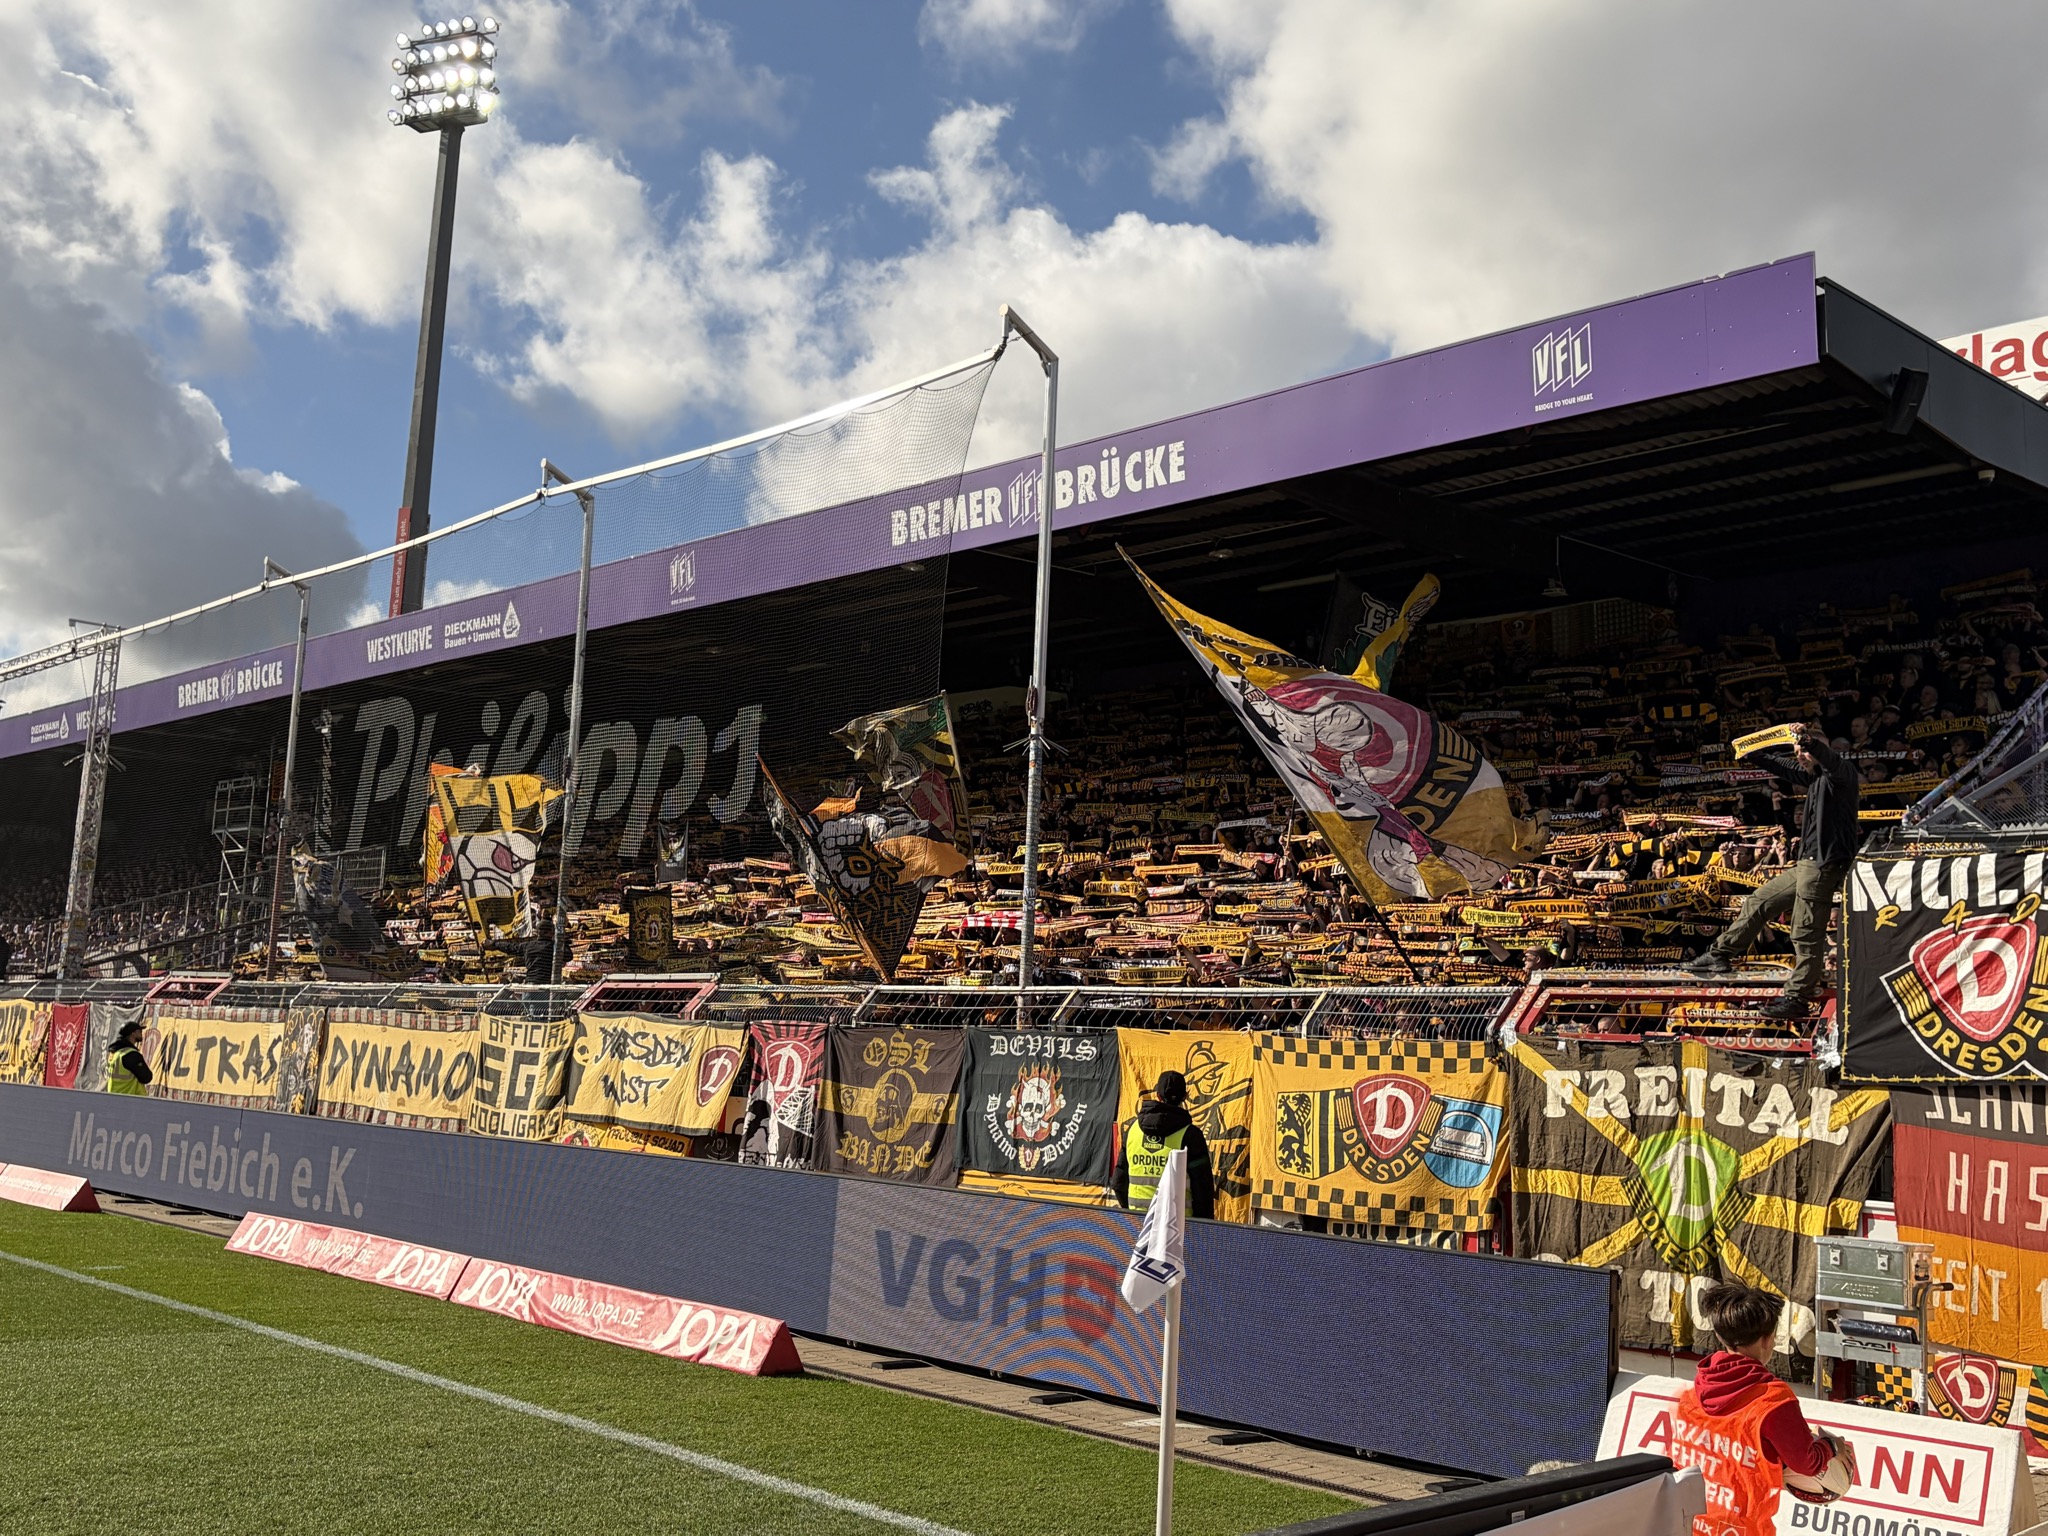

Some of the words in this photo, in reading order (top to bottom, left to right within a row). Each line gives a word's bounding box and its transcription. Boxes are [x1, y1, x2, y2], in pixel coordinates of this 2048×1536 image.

[1534, 330, 1590, 390] VFL
[1562, 398, 1576, 406] YOUR
[891, 487, 1003, 547] BREMER
[1055, 440, 1186, 510] BRÜCKE
[367, 625, 433, 663] WESTKURVE
[444, 614, 501, 637] DIECKMANN
[444, 638, 466, 649] Bauen
[473, 628, 501, 642] Umwelt
[178, 677, 219, 708] BREMER
[237, 660, 282, 694] BRÜCKE
[1550, 904, 1589, 914] DYNAMO
[161, 1031, 282, 1085] ULTRAS
[327, 1035, 476, 1101] DYNAMO
[989, 1034, 1097, 1061] DEVILS
[601, 1070, 669, 1107] WEST
[1542, 1065, 1849, 1146] FREITAL
[469, 1103, 560, 1138] HOOLIGANS
[984, 1093, 1017, 1160] Dynamo
[1040, 1102, 1088, 1166] Dresden
[68, 1111, 152, 1178] Marco
[161, 1121, 281, 1202] Fiebich
[291, 1145, 364, 1219] e.K.
[1342, 1128, 1431, 1182] DRESDEN
[875, 1230, 1047, 1332] VGH
[550, 1293, 645, 1328] WWW.JOPA.DE
